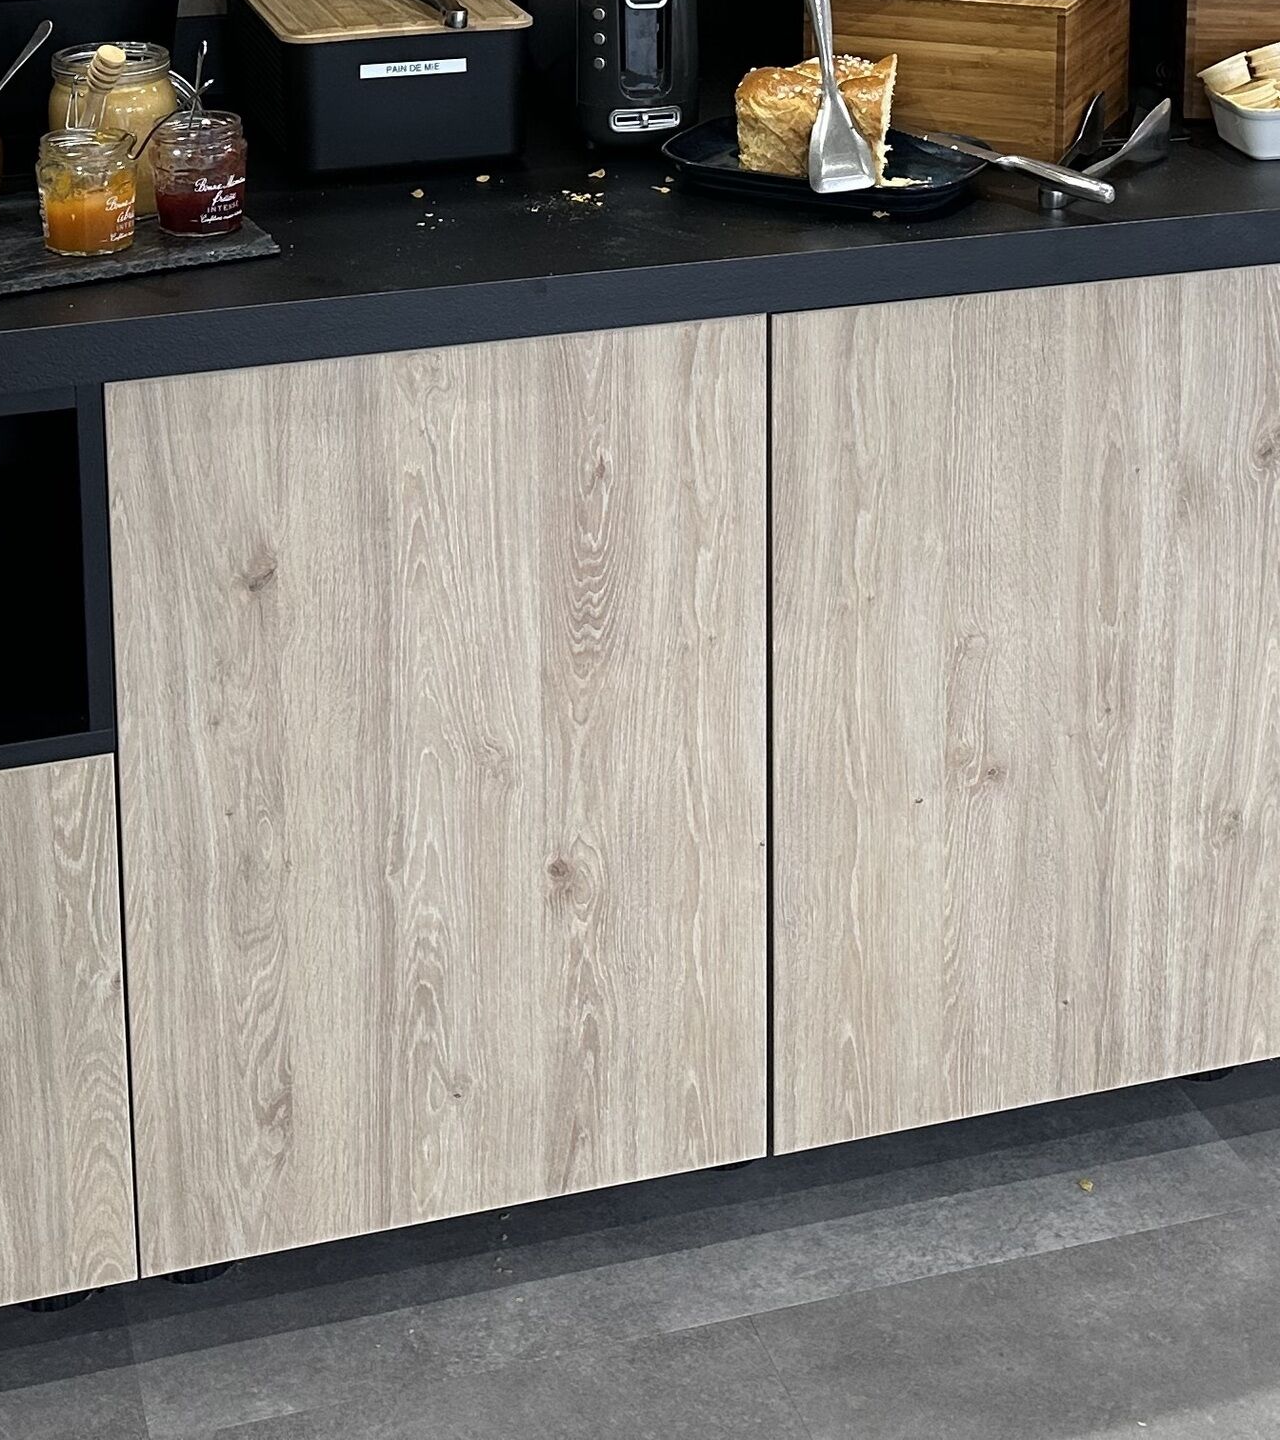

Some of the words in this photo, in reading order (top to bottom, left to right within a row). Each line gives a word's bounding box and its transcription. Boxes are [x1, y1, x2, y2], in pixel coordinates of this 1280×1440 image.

[386, 64, 408, 74] PAIN
[409, 63, 422, 72] DE
[424, 63, 440, 72] MIE
